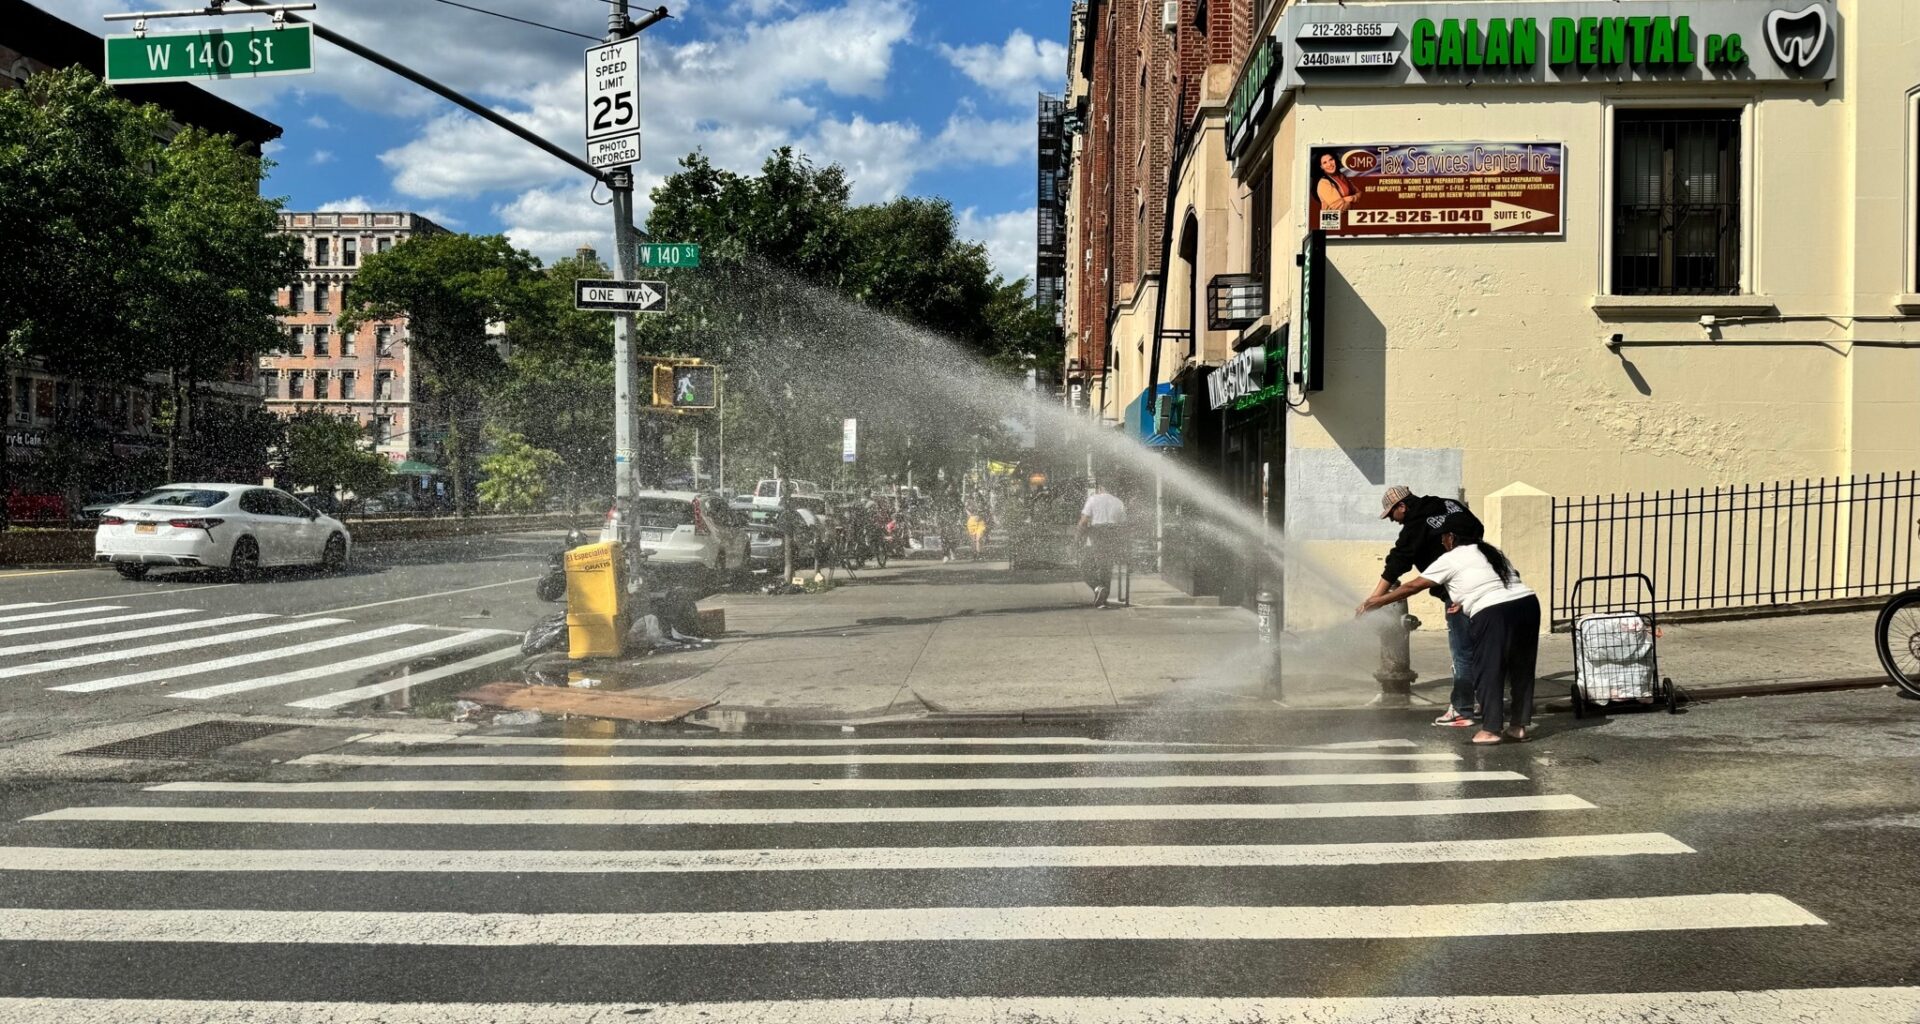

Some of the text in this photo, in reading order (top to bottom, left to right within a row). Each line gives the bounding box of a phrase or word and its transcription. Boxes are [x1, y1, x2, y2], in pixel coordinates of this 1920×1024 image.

[1312, 23, 1382, 36] 212-283-6555
[1411, 17, 1537, 66] GALAN
[1551, 16, 1694, 64] DENTAL
[146, 37, 274, 71] W 140 St
[600, 47, 622, 62] CITY
[1360, 54, 1381, 63] SUITE
[1382, 52, 1393, 63] 1A
[595, 61, 627, 77] SPEED
[599, 76, 624, 91] LIMIT
[593, 90, 633, 131] 25
[599, 139, 627, 153] PHOTO
[591, 149, 636, 165] ENFORCED
[1349, 156, 1374, 168] JMR
[1378, 144, 1555, 174] Tax Services Center Inc.
[1322, 213, 1339, 221] IRS
[1356, 210, 1483, 223] 212-926-1040
[1494, 211, 1532, 220] SUITE 1C
[641, 246, 694, 264] W 140 St
[589, 289, 653, 302] ONE WAY
[585, 561, 610, 570] GRATIS
